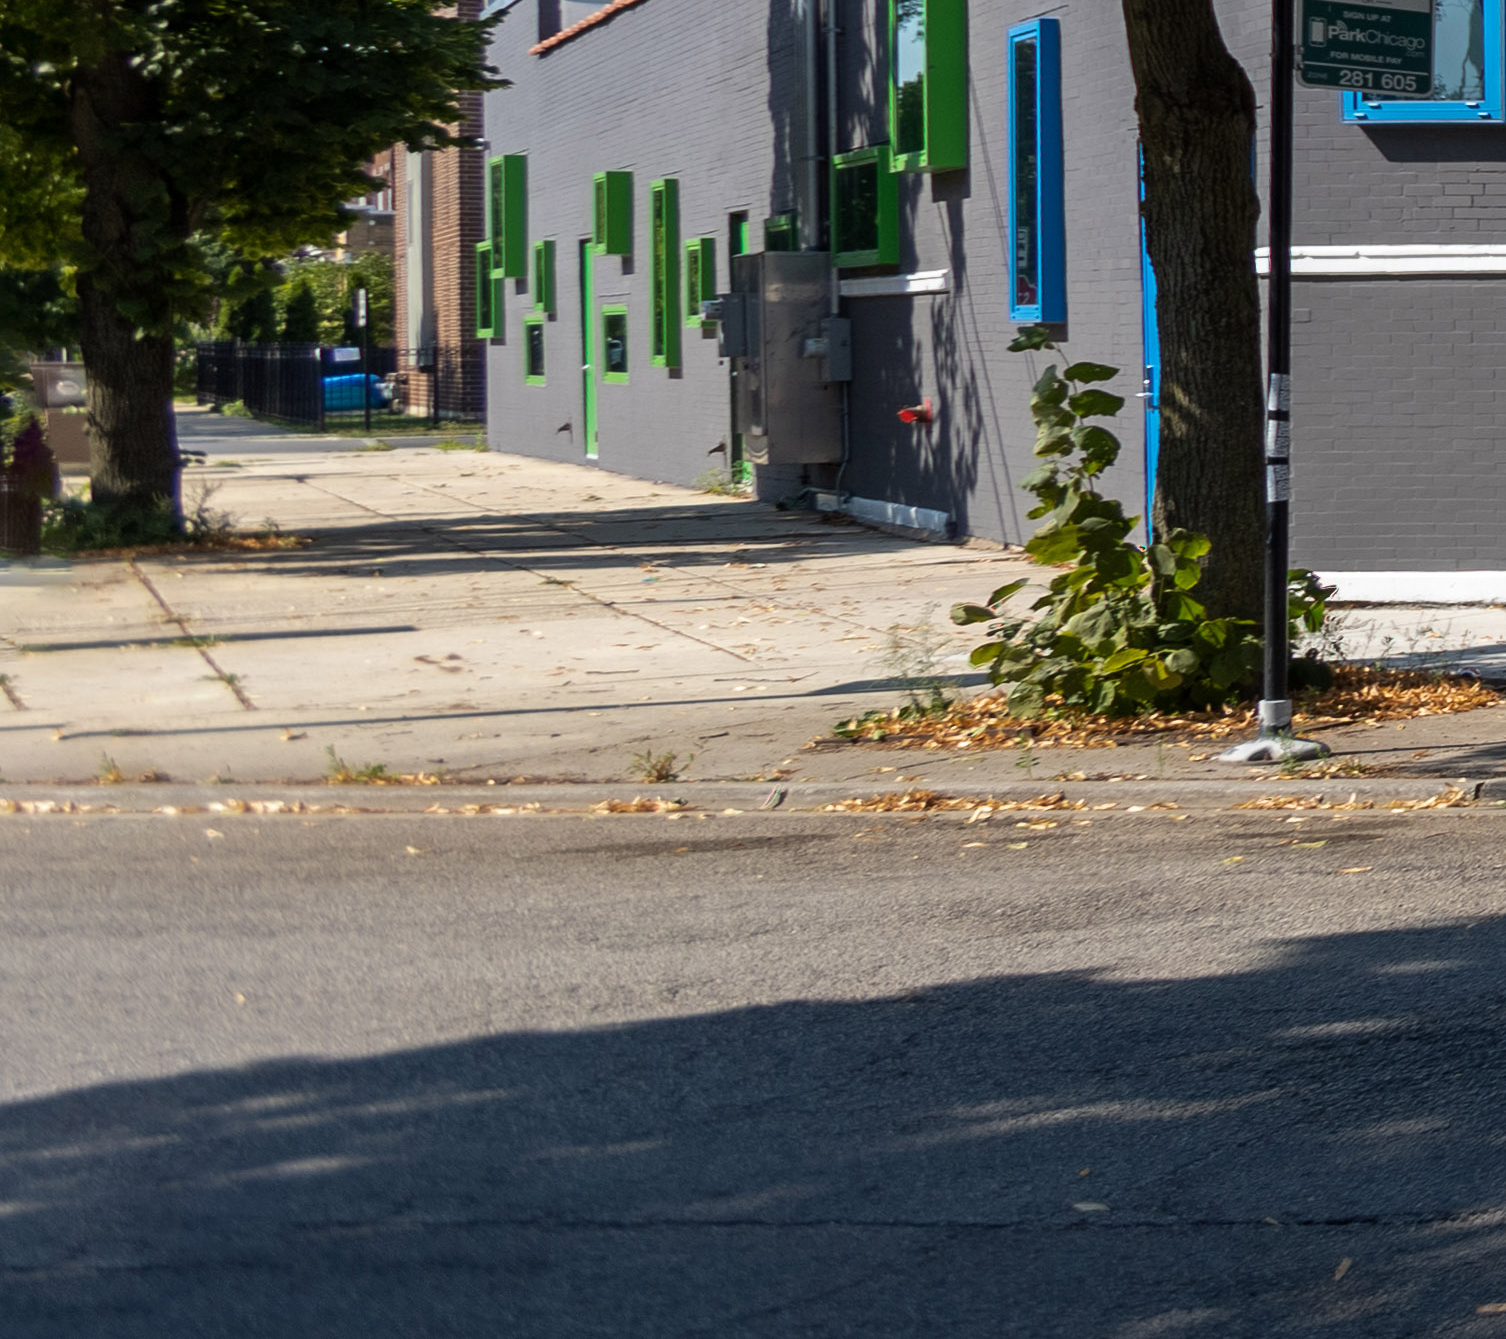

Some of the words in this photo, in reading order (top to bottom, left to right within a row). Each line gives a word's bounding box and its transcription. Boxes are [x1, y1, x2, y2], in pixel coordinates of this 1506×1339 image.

[1343, 11, 1365, 20] SIGN
[1366, 13, 1379, 21] UP
[1328, 25, 1426, 51] ParkChicago
[1330, 51, 1349, 60] FOR
[1350, 53, 1385, 63] MOBILE
[1386, 56, 1402, 64] PAY
[1339, 70, 1374, 88] 281
[1381, 73, 1417, 91] 605
